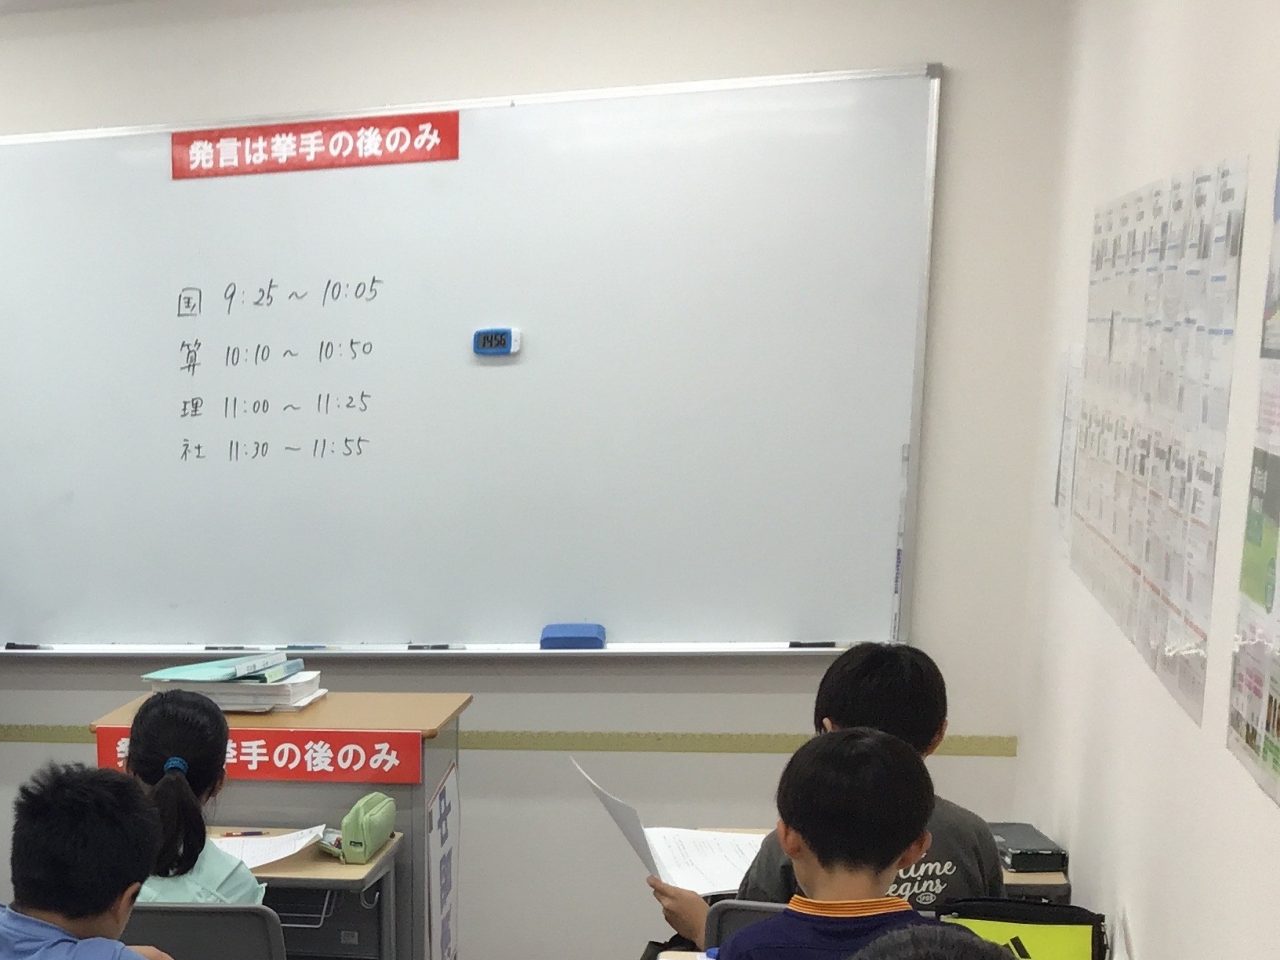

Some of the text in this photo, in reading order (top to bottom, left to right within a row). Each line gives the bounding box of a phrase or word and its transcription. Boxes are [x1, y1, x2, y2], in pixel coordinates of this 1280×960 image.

[188, 122, 441, 171] 発言は挙手の後のみ
[177, 287, 202, 317] 国
[224, 278, 278, 315] 9:25
[323, 276, 384, 307] 10:05
[180, 338, 202, 376] 算
[226, 344, 271, 366] 10:10
[320, 339, 373, 363] 10:50
[181, 397, 203, 418] 理
[225, 396, 270, 419] 11:00
[317, 391, 371, 415] 11:25
[181, 439, 206, 461] 社
[229, 440, 269, 462] 11:30
[313, 436, 370, 459] 11:55
